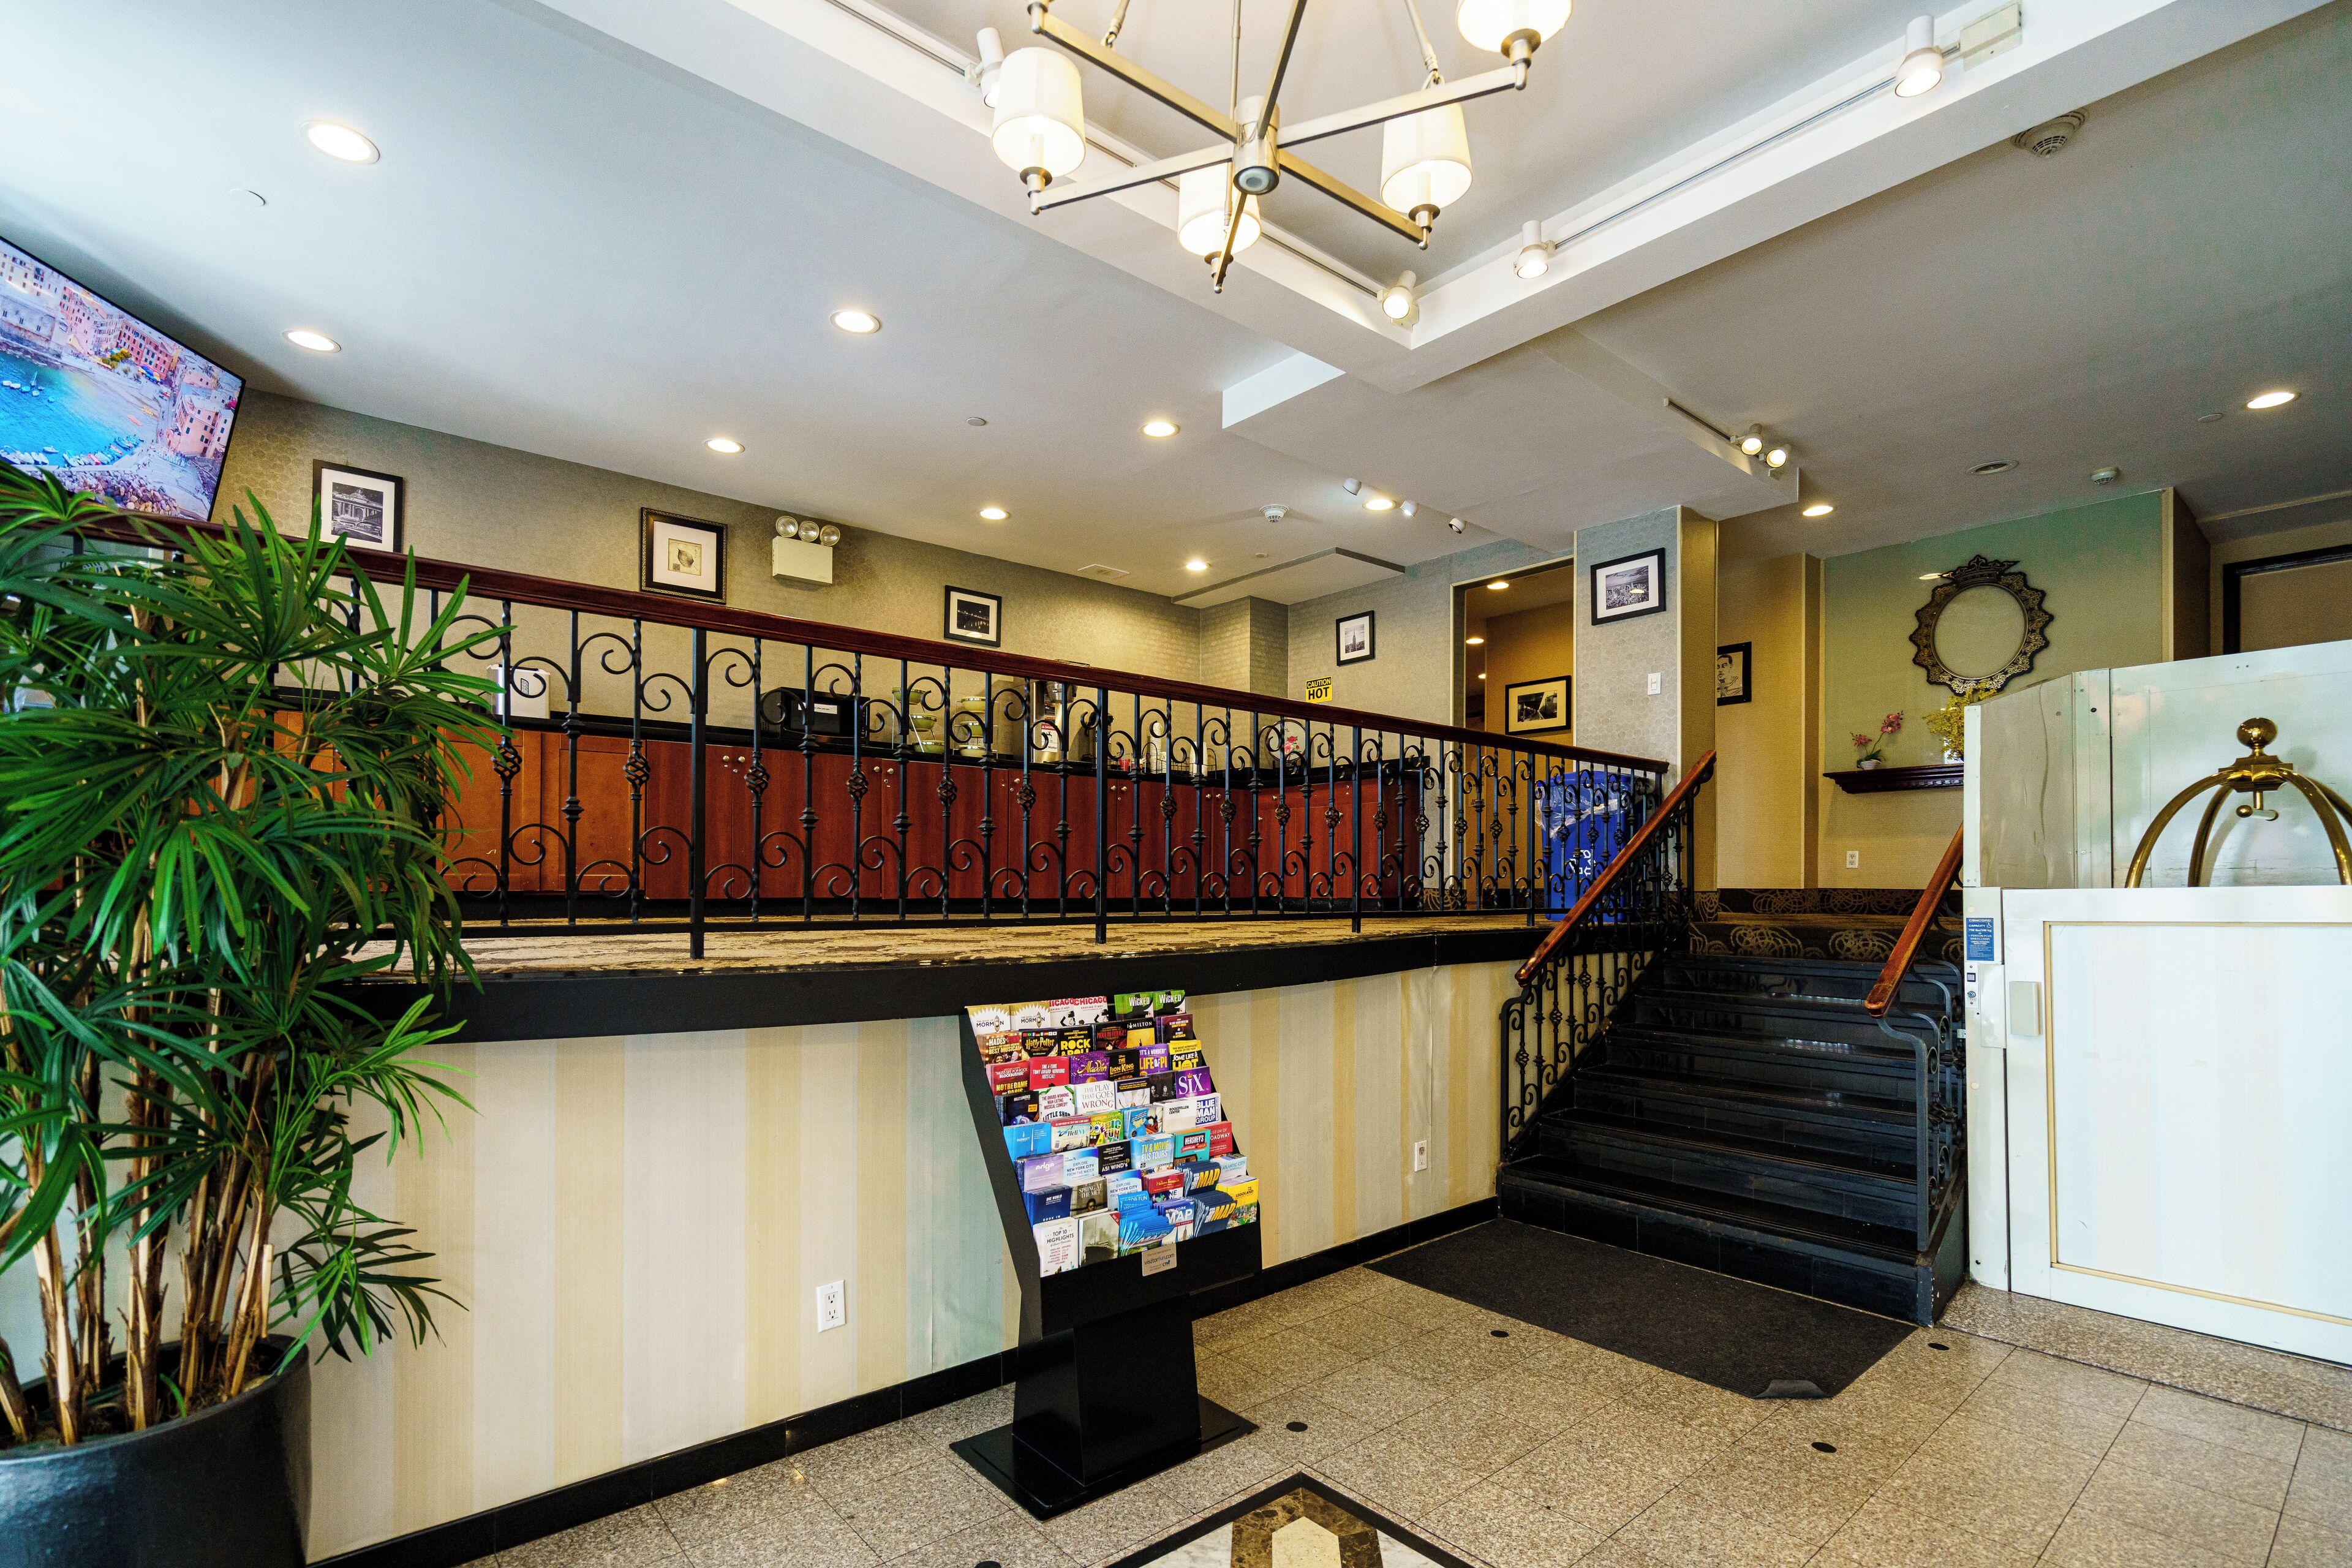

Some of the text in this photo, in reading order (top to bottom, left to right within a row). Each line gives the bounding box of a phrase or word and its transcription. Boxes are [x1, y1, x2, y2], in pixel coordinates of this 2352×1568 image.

[1307, 678, 1331, 688] CAUTION
[1308, 687, 1330, 700] HOT
[1073, 996, 1107, 1006] CHICAGO
[1025, 1037, 1054, 1050] Harry Potter
[1061, 1039, 1090, 1050] ROCK
[1077, 1060, 1107, 1074] Aladdin
[1121, 1063, 1134, 1072] KING
[1140, 1057, 1167, 1070] LIFE OF PI
[996, 1080, 1028, 1091] NOTRE DAME
[1095, 1084, 1110, 1092] PLAY
[1096, 1091, 1114, 1099] GOES
[1082, 1099, 1114, 1109] WRONG
[1196, 1099, 1215, 1109] BLUE
[1042, 1111, 1058, 1121] LITTLE
[1197, 1107, 1215, 1118] MAN
[1196, 1114, 1216, 1124] GROUP
[1101, 1120, 1121, 1133] EPIC
[1104, 1129, 1120, 1140] FUN
[1185, 1134, 1204, 1145] HERSHEY'S
[1142, 1140, 1168, 1153] TV & MOVIE
[1142, 1153, 1152, 1162] BUS
[1152, 1150, 1168, 1159] TOURS
[1196, 1169, 1221, 1188] MAP
[1210, 1203, 1236, 1222] MAP
[1047, 1233, 1074, 1243] HIGHLIGHTS
[1145, 1253, 1175, 1265] visitorfun.com
